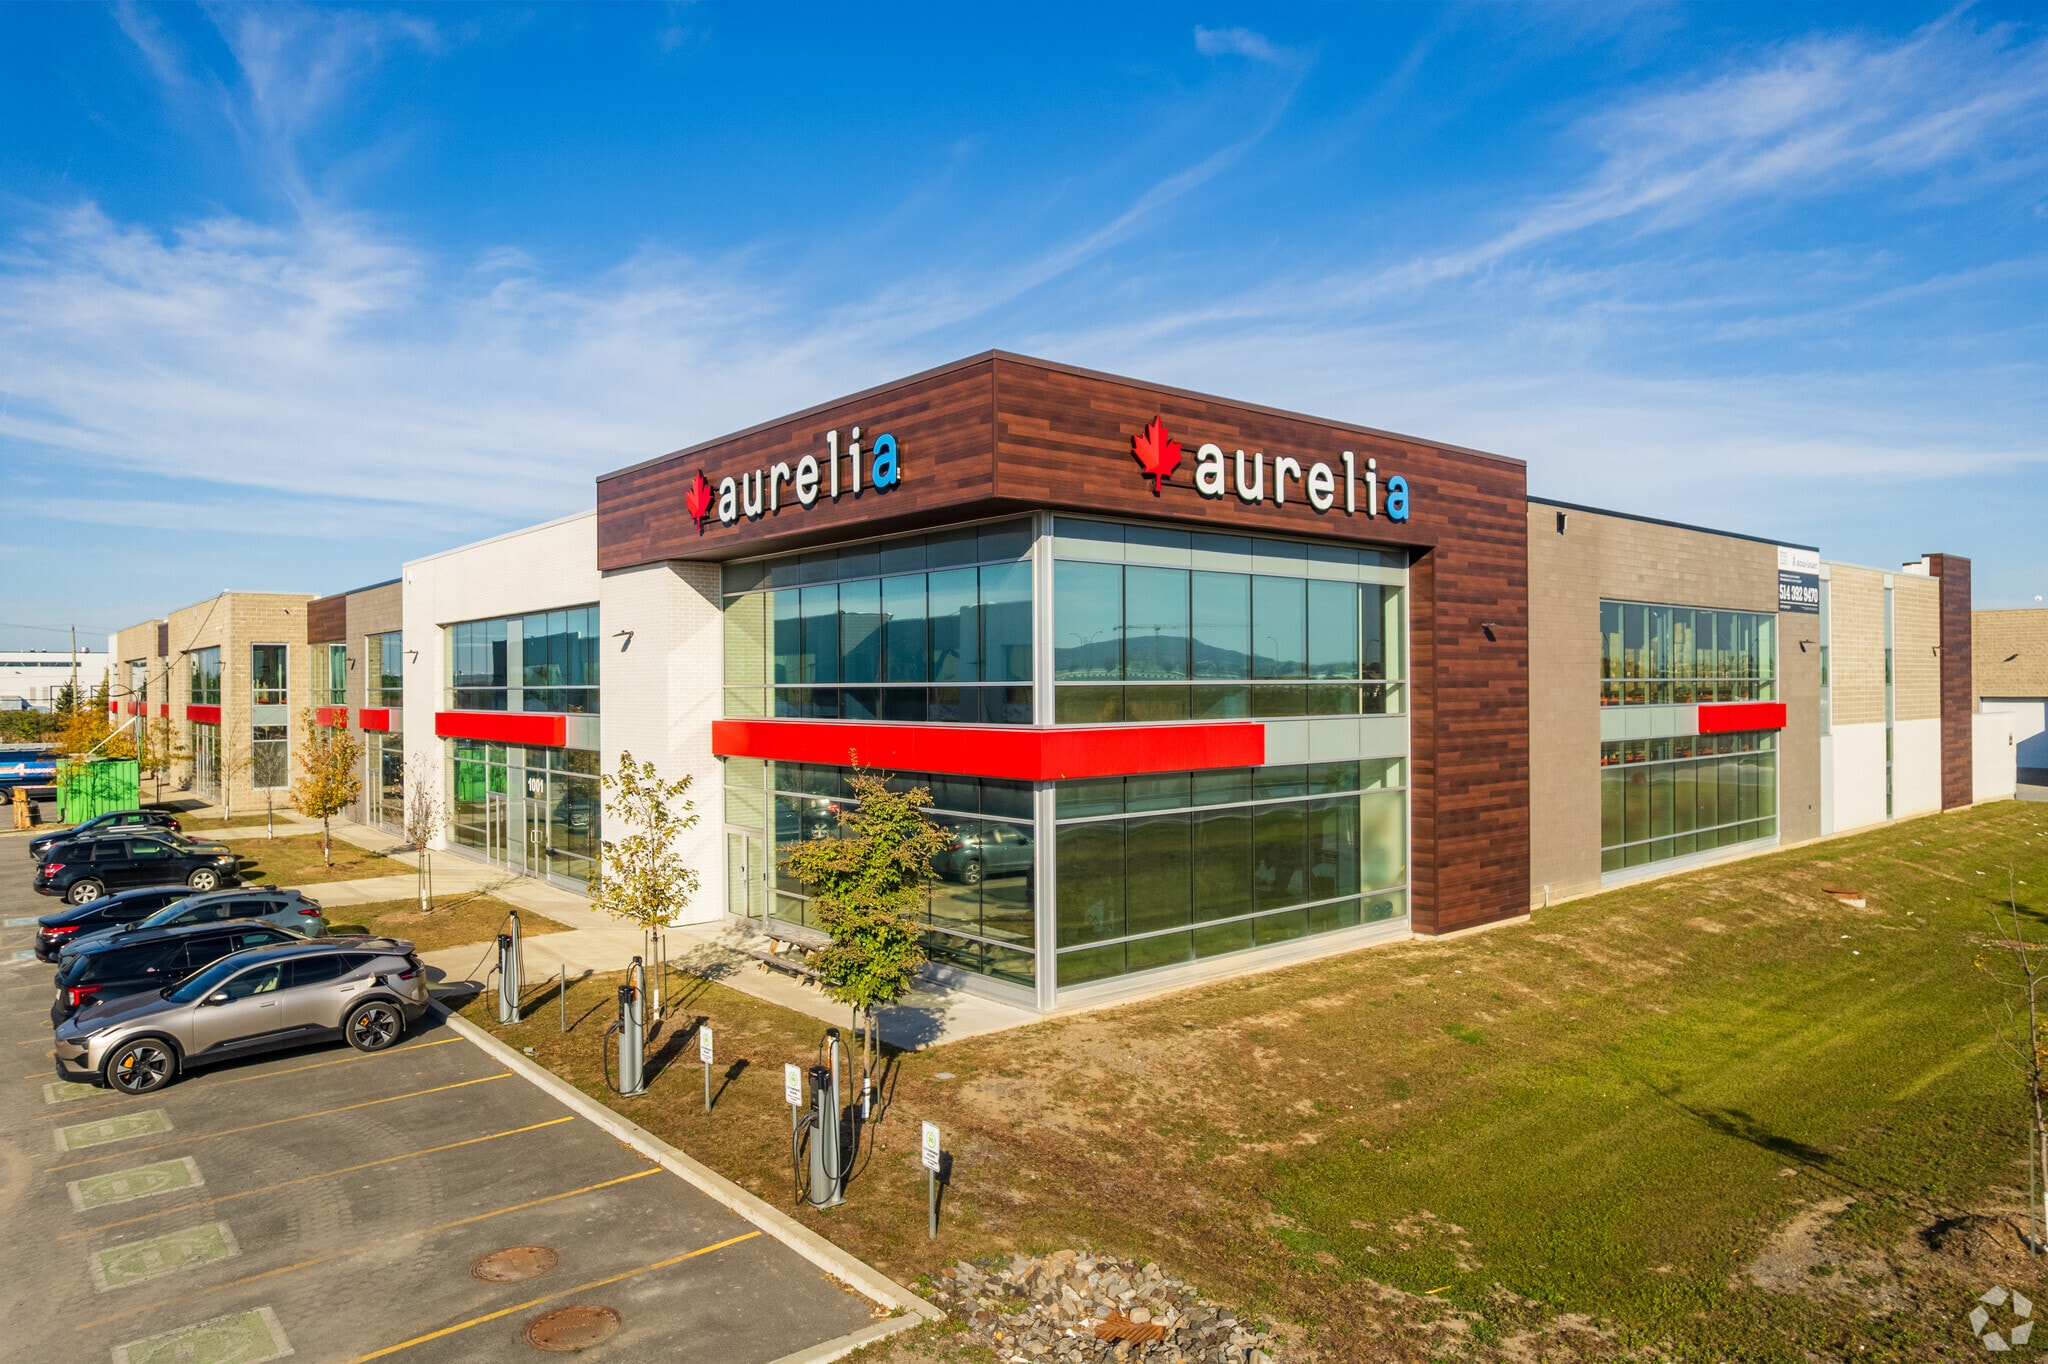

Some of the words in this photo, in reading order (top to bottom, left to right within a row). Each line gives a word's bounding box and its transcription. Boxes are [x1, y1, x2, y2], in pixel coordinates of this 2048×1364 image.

[718, 426, 899, 523] aurelia
[1195, 443, 1409, 520] aurelia
[1779, 584, 1791, 600] 514
[1791, 585, 1803, 601] 392
[1803, 587, 1819, 603] 9470
[528, 777, 544, 793] 1001
